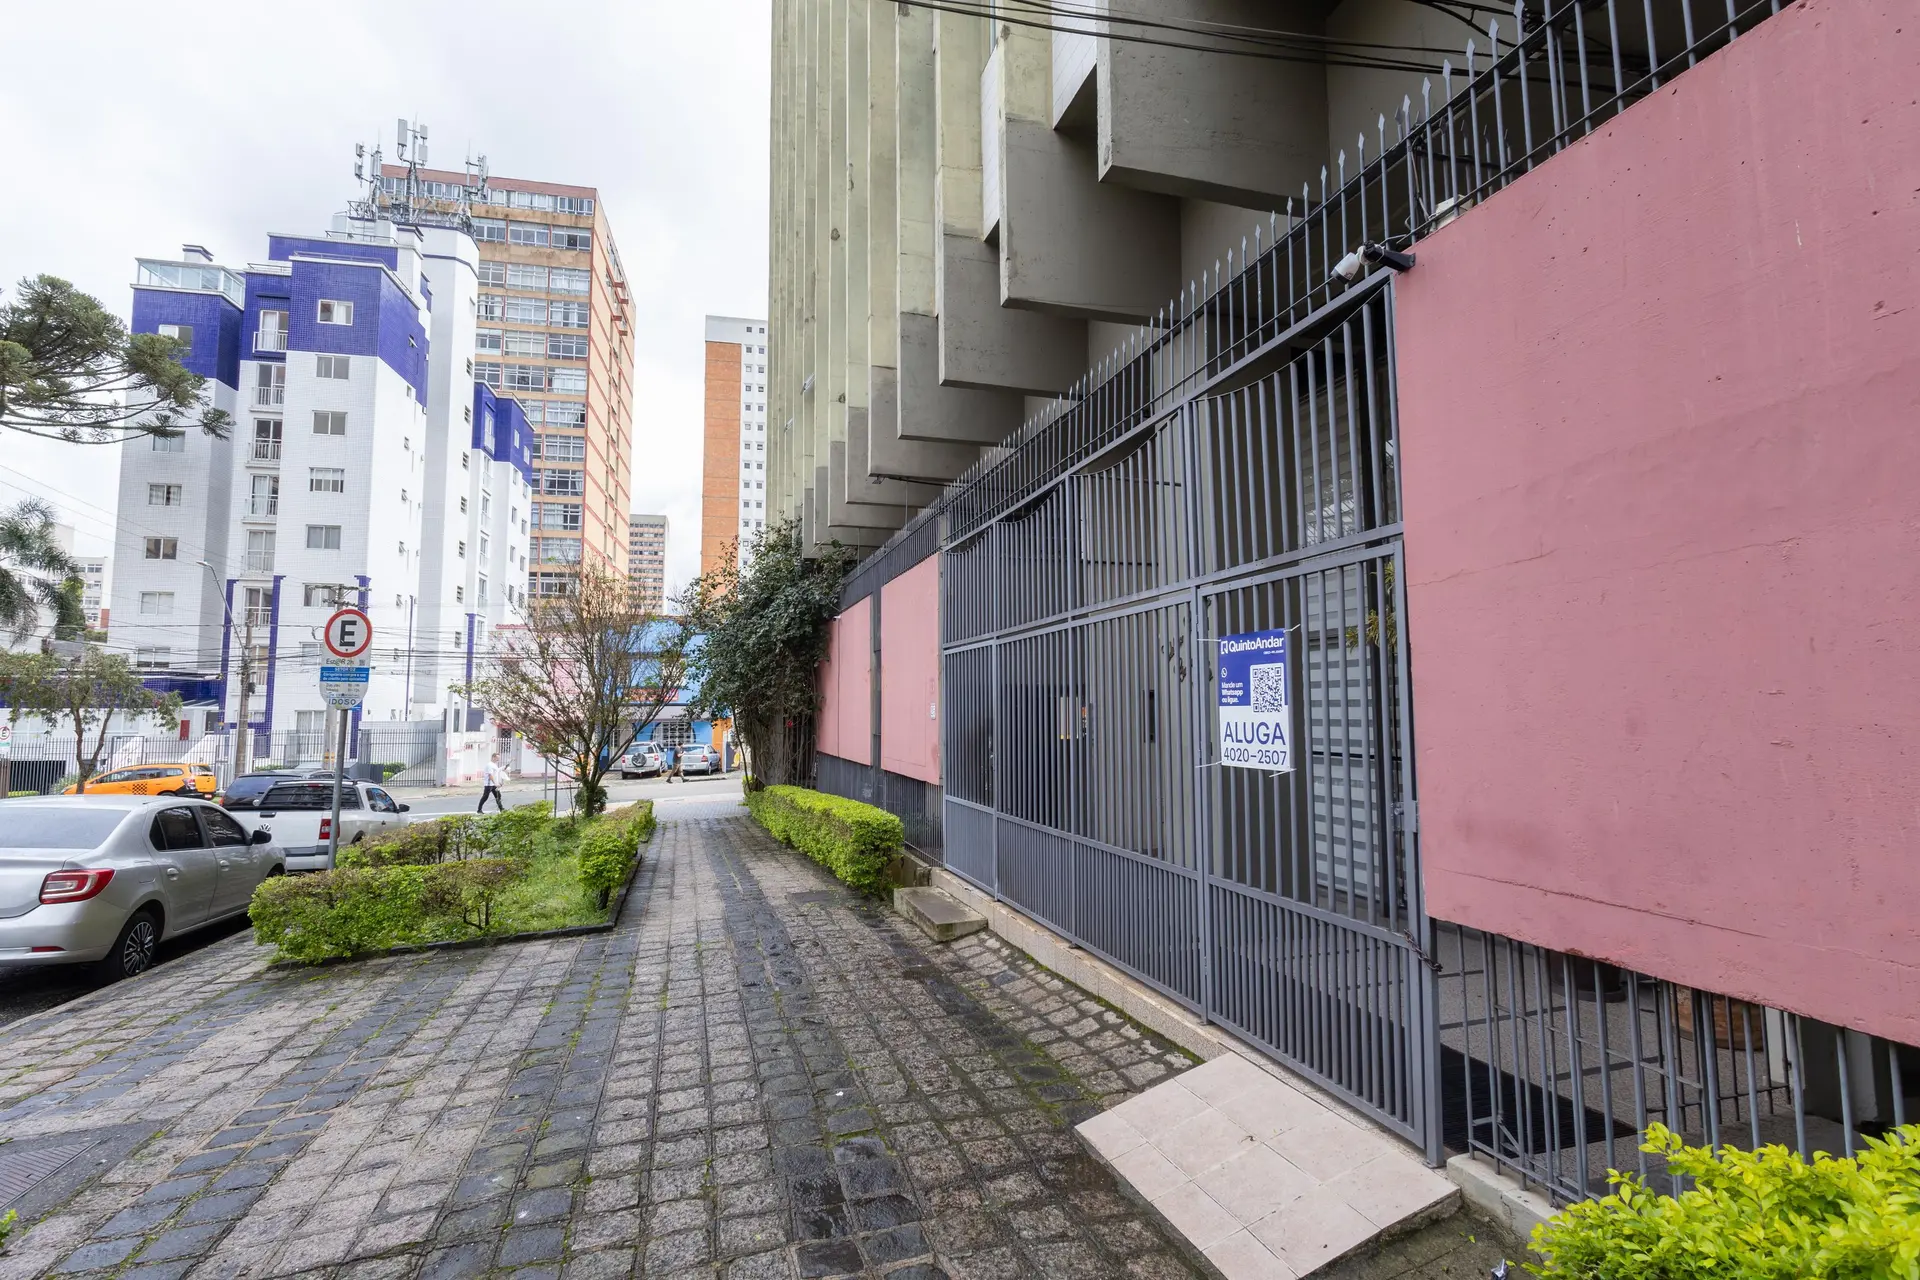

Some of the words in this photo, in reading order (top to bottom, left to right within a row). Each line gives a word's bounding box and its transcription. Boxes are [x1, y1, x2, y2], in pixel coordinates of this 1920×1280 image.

[339, 620, 357, 646] E
[1229, 636, 1284, 652] QuintoAndar
[1223, 721, 1286, 746] ALUGA
[1223, 747, 1287, 766] 4020-2507
